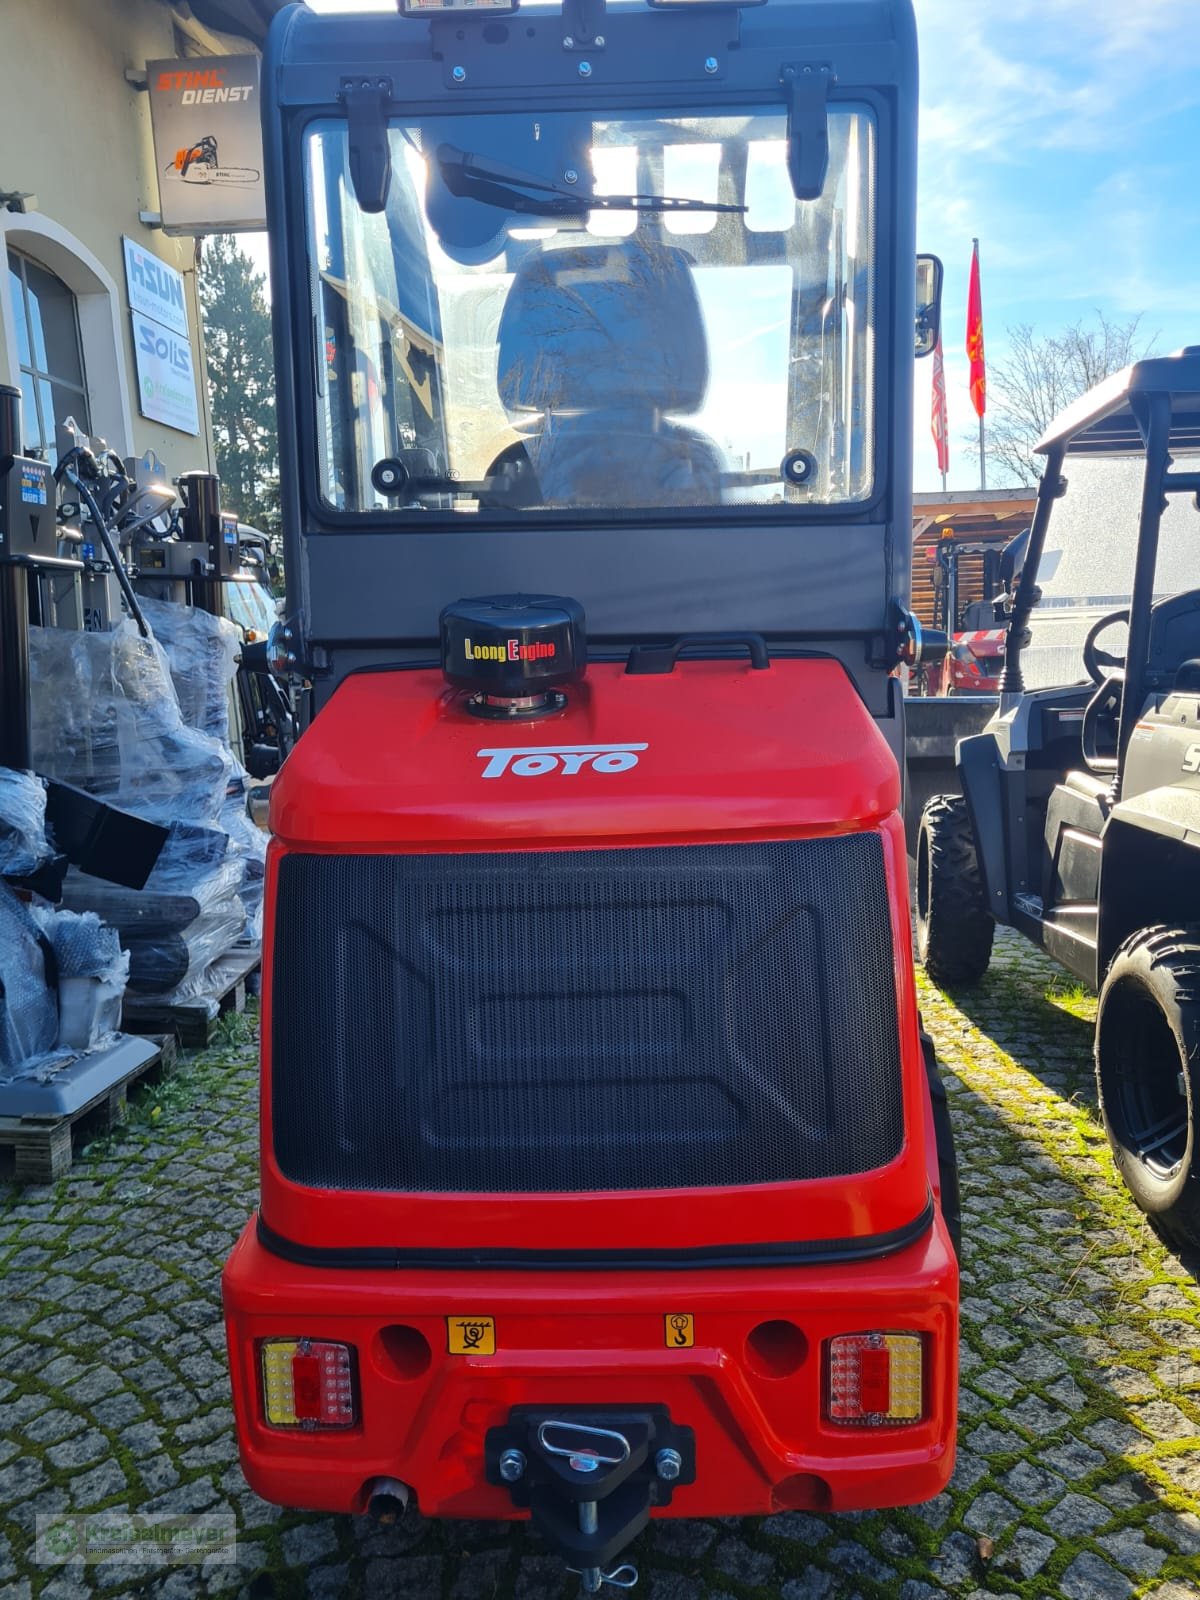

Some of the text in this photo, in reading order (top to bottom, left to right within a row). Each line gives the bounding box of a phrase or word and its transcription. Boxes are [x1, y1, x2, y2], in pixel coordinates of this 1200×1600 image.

[156, 69, 225, 92] STIHL
[181, 86, 253, 105] DIENST
[476, 742, 649, 778] TOYO
[1181, 743, 1200, 774] S
